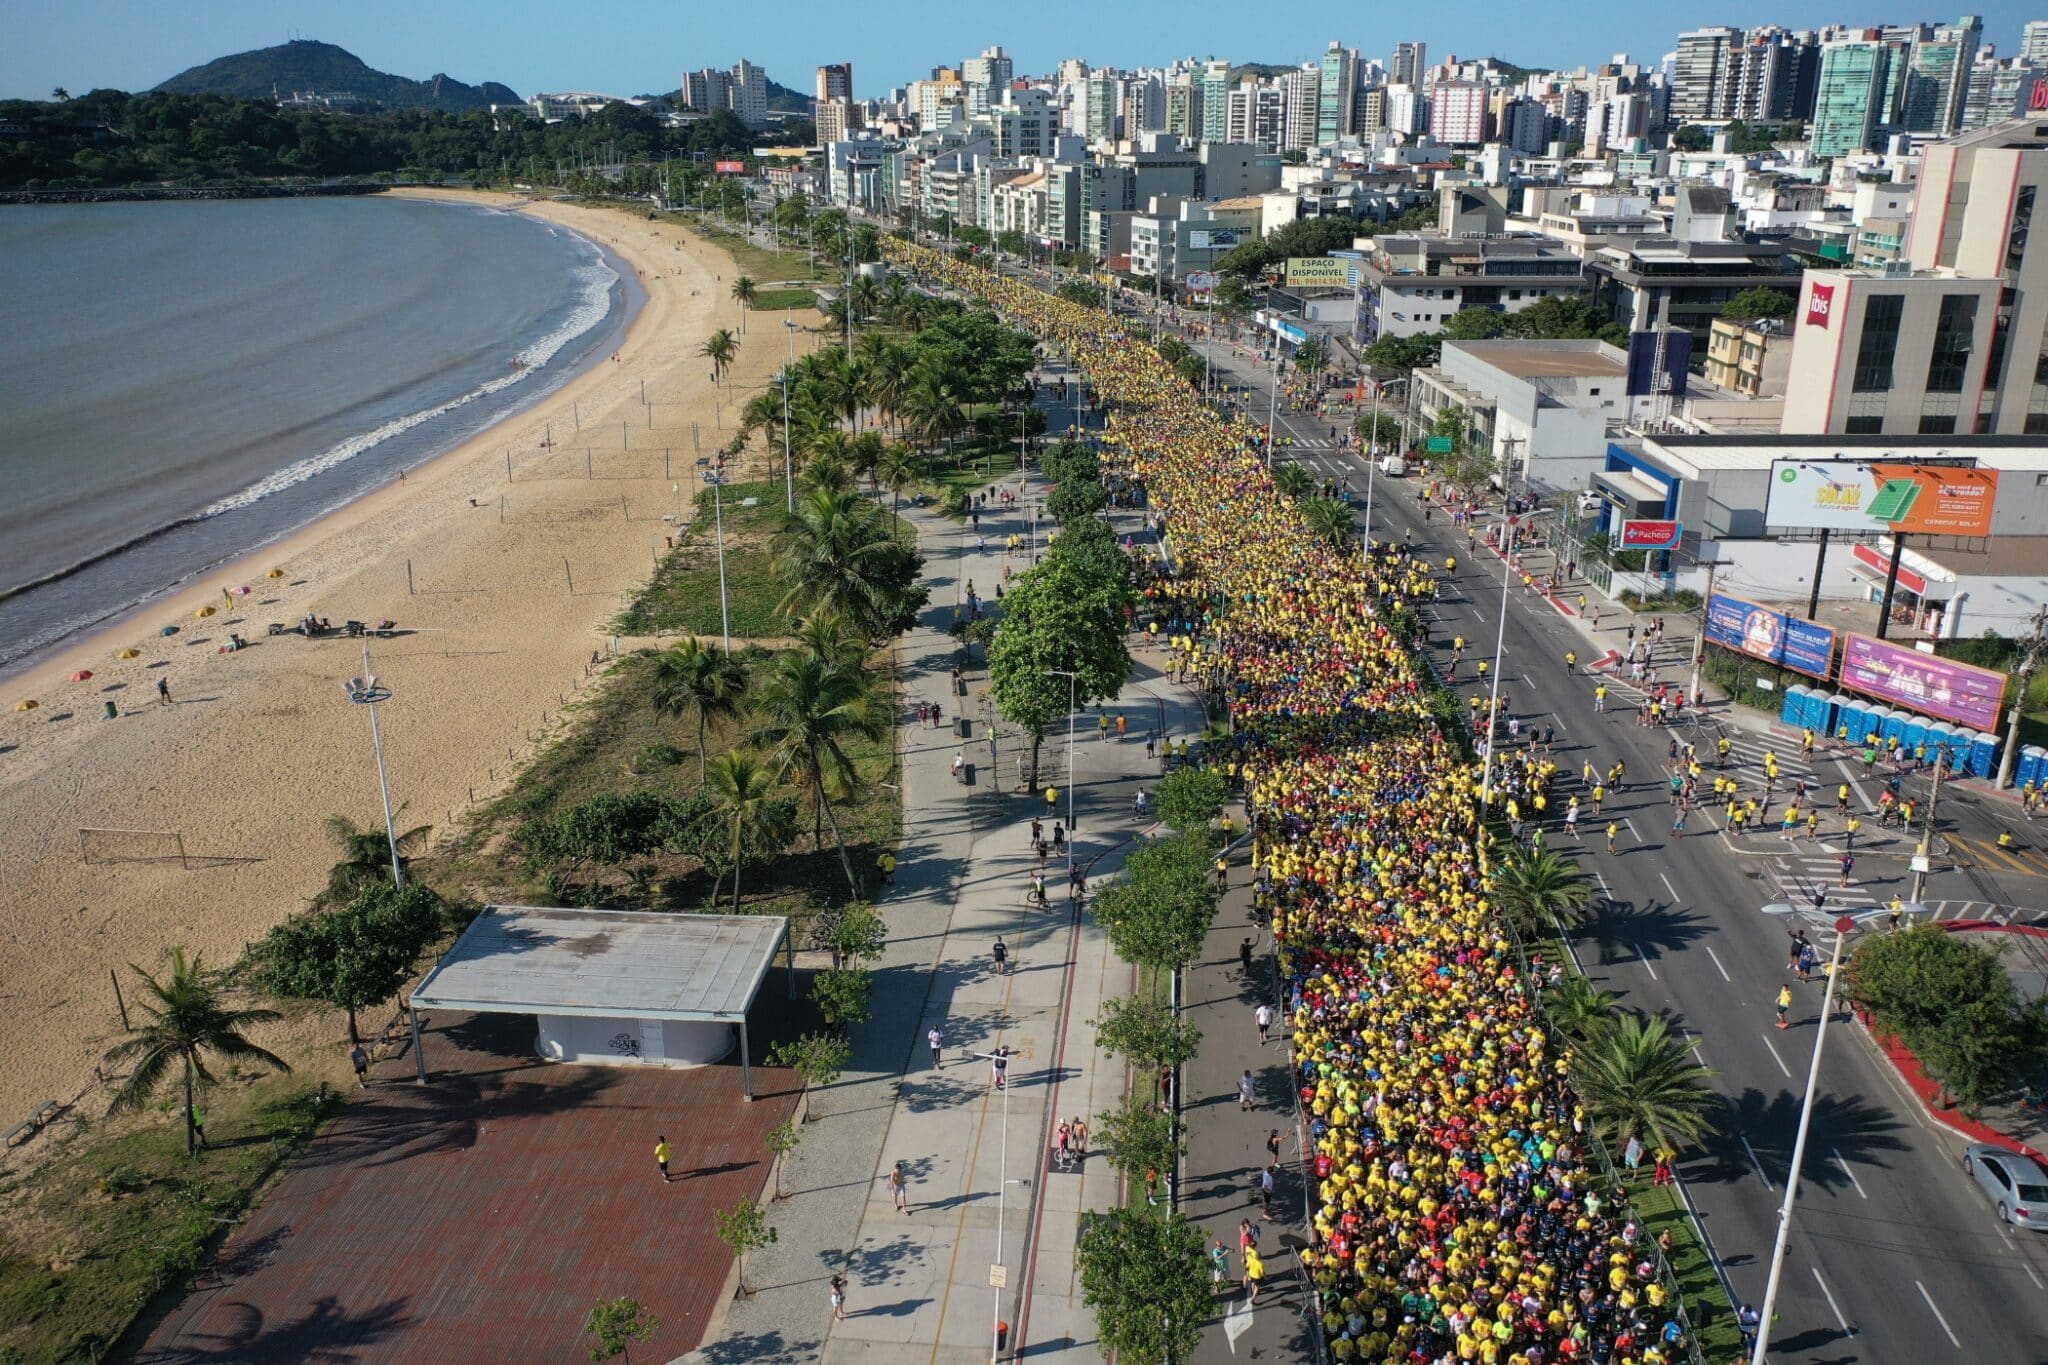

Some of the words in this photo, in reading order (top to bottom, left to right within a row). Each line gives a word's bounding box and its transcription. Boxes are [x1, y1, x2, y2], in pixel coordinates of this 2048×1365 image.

[1301, 259, 1335, 268] ESPAÇO
[1810, 293, 1828, 315] ibis
[1638, 530, 1671, 539] Pacheco
